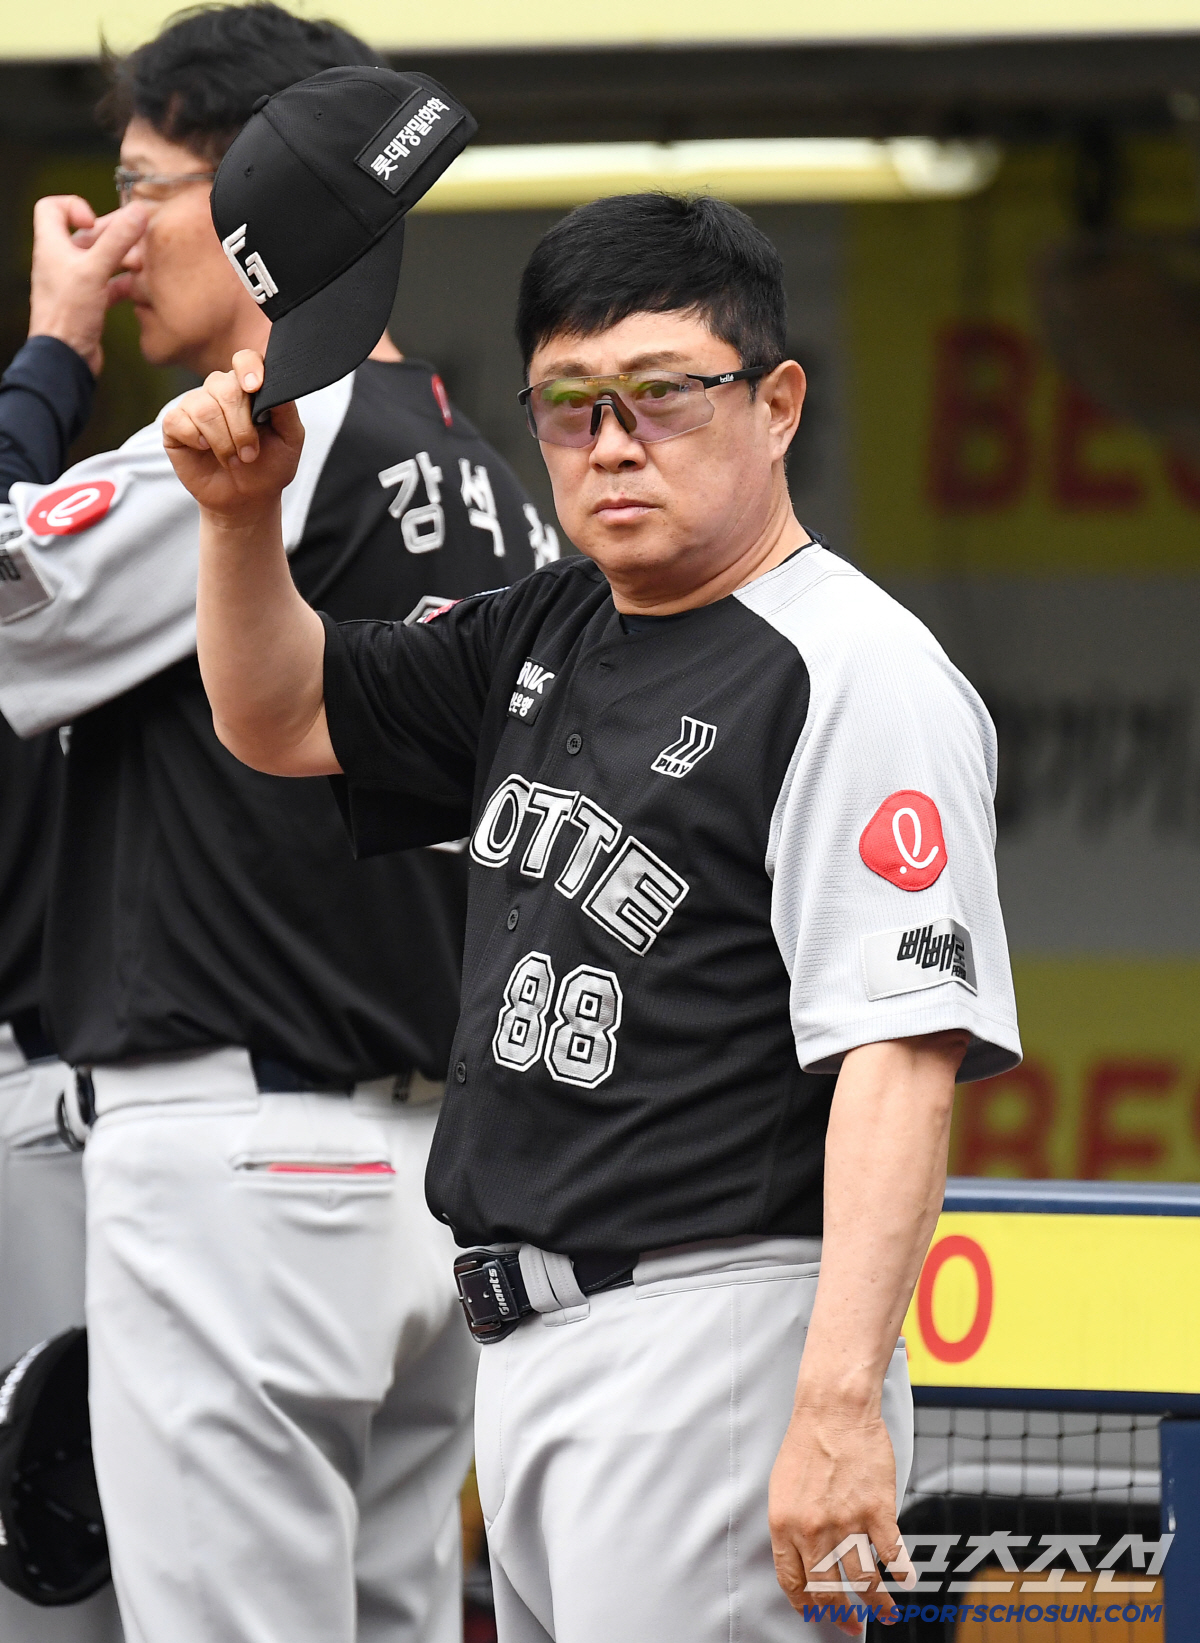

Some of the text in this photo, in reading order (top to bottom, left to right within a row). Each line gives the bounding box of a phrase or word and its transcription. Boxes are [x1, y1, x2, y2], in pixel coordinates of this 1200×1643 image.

[370, 97, 450, 181] 롯데정밀화학
[516, 661, 556, 695] NK
[655, 757, 690, 775] PLAY
[469, 773, 690, 957] OTTE
[492, 950, 624, 1090] 88
